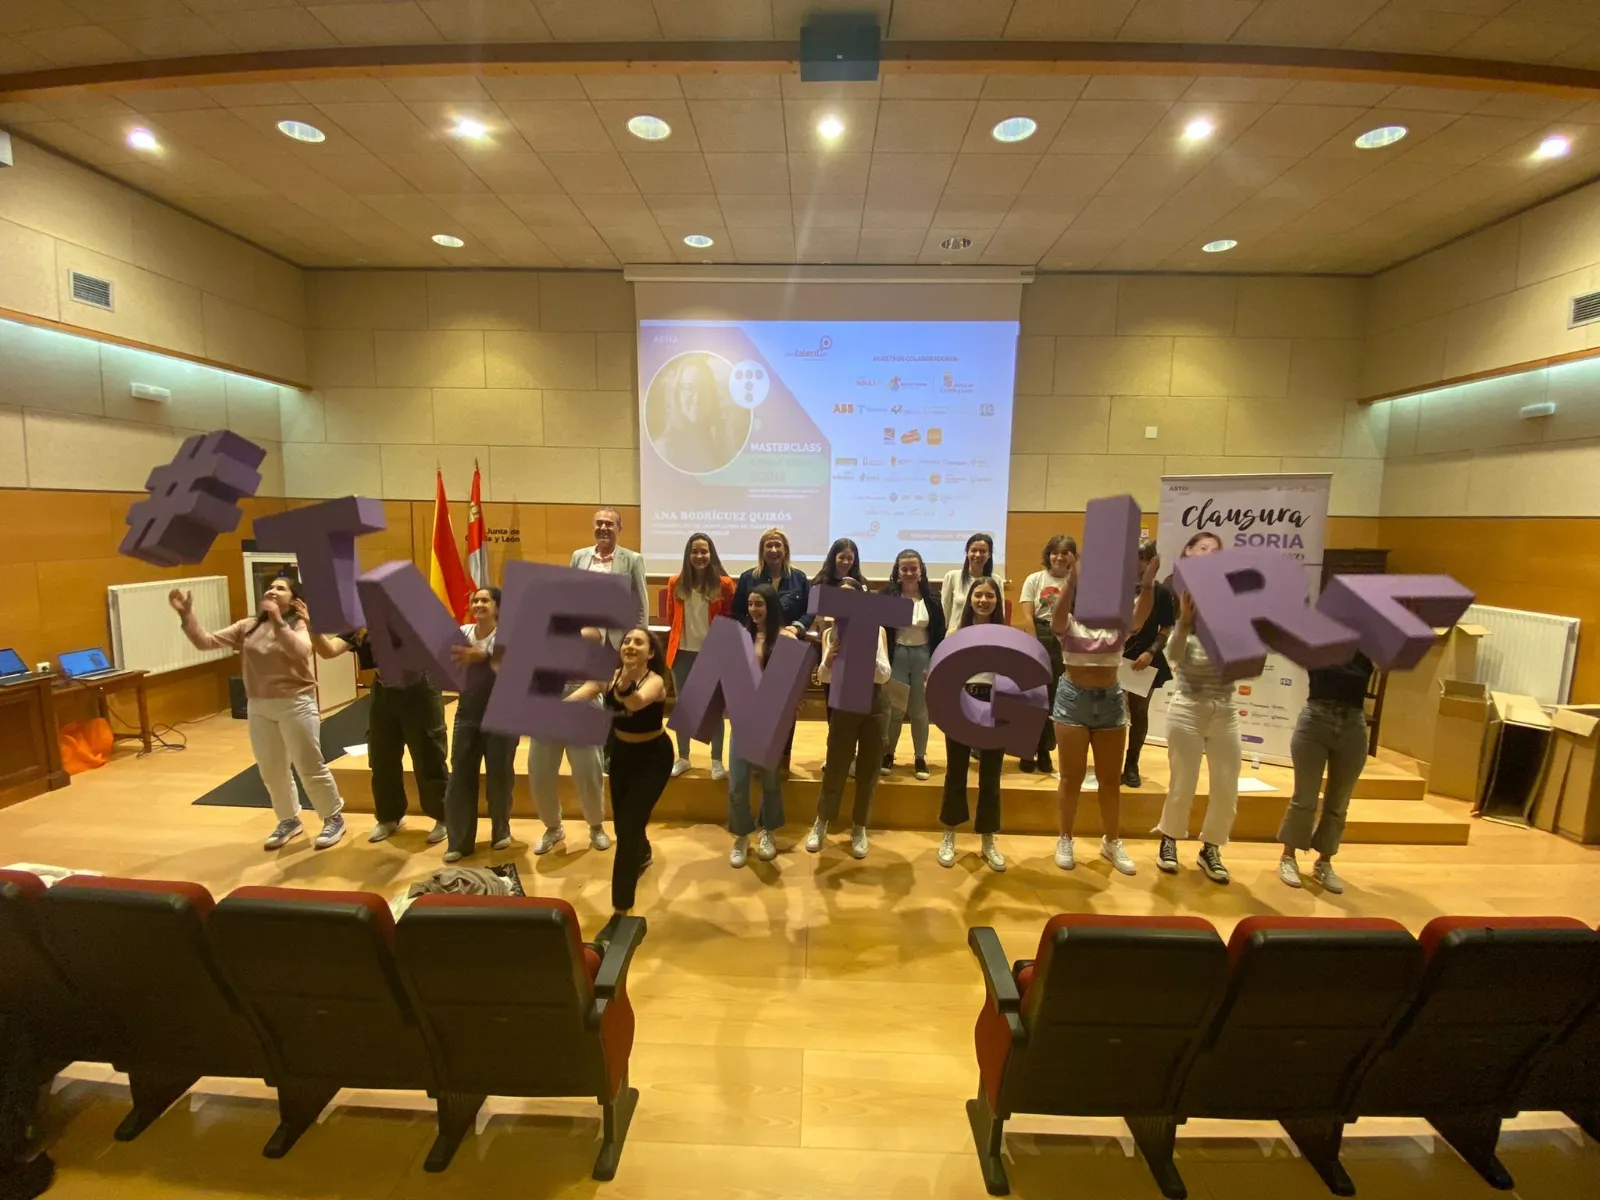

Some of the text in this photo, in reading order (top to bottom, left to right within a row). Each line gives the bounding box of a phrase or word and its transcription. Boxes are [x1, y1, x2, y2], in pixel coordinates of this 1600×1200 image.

[833, 403, 854, 414] ABB
[750, 442, 822, 452] MASTERCLASS
[652, 508, 792, 522] ANA RODRÍGUEZ QUIRÓS
[486, 527, 520, 535] Junta de
[501, 534, 520, 542] León
[1234, 533, 1305, 549] SORIA
